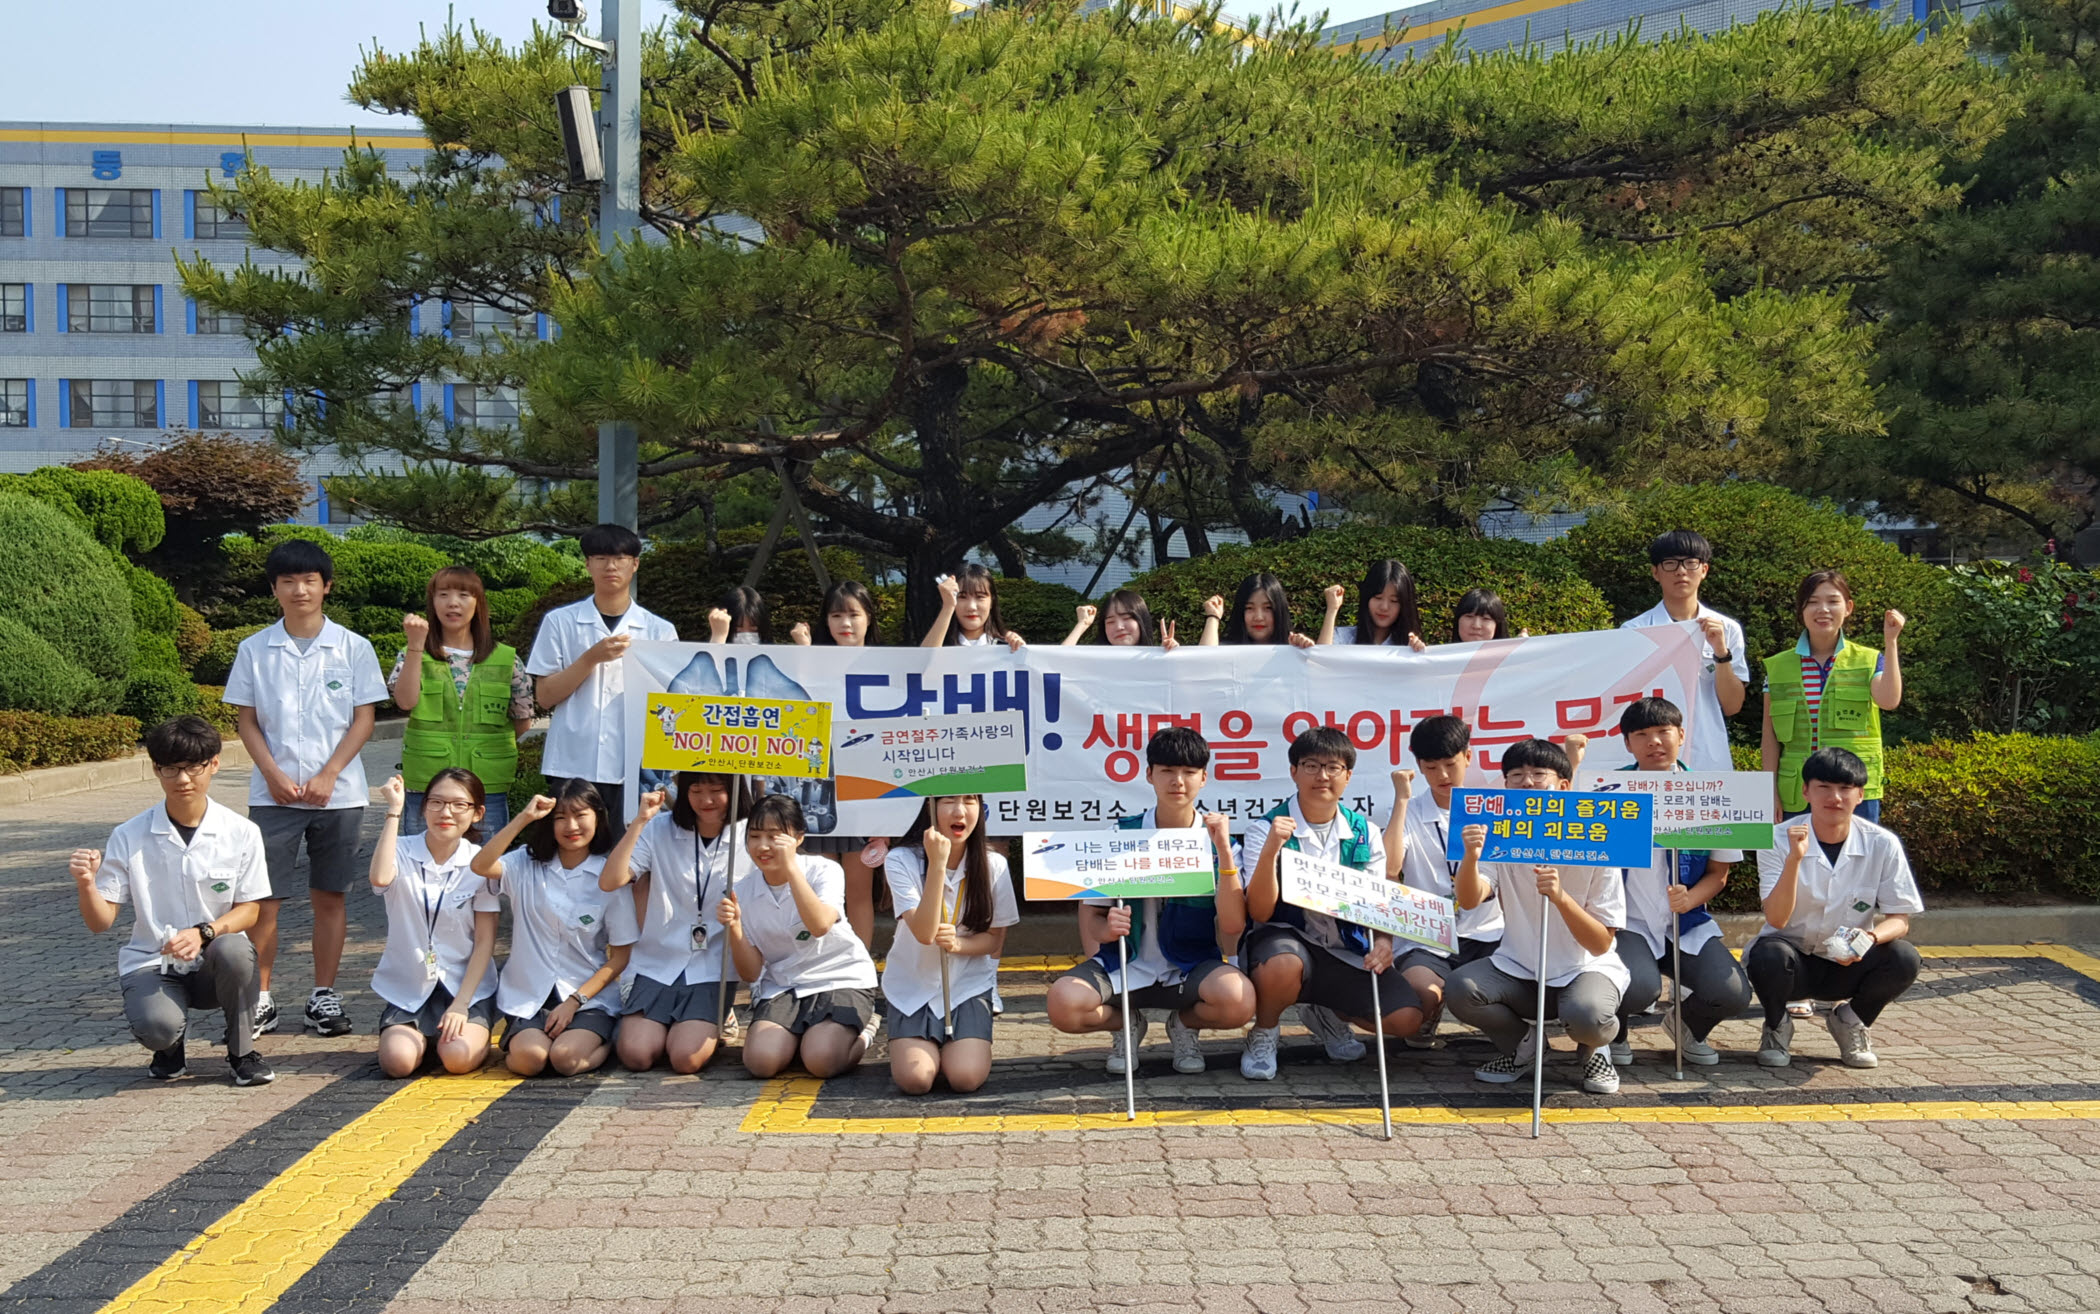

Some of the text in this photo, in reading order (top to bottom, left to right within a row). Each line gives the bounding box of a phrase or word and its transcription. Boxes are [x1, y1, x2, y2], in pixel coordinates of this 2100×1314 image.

[702, 704, 780, 729] 간접흡연
[880, 724, 1014, 745] 금연절주가족사랑의
[673, 732, 804, 759] NO! NO! NO!
[882, 747, 955, 764] 시작입니다
[708, 758, 783, 770] 안산시 단원보건소
[908, 765, 985, 777] 안산시 단원보건소
[1627, 780, 1724, 792] 담배가 좋으십니까?
[1663, 795, 1695, 806] 모르게
[1700, 795, 1731, 806] 담배는
[998, 799, 1128, 822] 단원보건소
[1575, 799, 1641, 820] 즐거움
[1663, 809, 1695, 821] 수명을
[1700, 809, 1764, 821] 단축시킵니다
[1492, 820, 1608, 842] 폐의 괴로움
[1653, 826, 1681, 834] 안산시
[1075, 838, 1203, 854] 나는 담배를 태우고,
[1510, 848, 1610, 861] 안산시 단원보건소
[1075, 856, 1200, 871] 담배는 나를 태운다
[1293, 857, 1364, 888] 멋부리고
[1411, 893, 1445, 916] 담배
[1297, 877, 1369, 909] 멋모르고
[1374, 901, 1446, 935] 죽어간다
